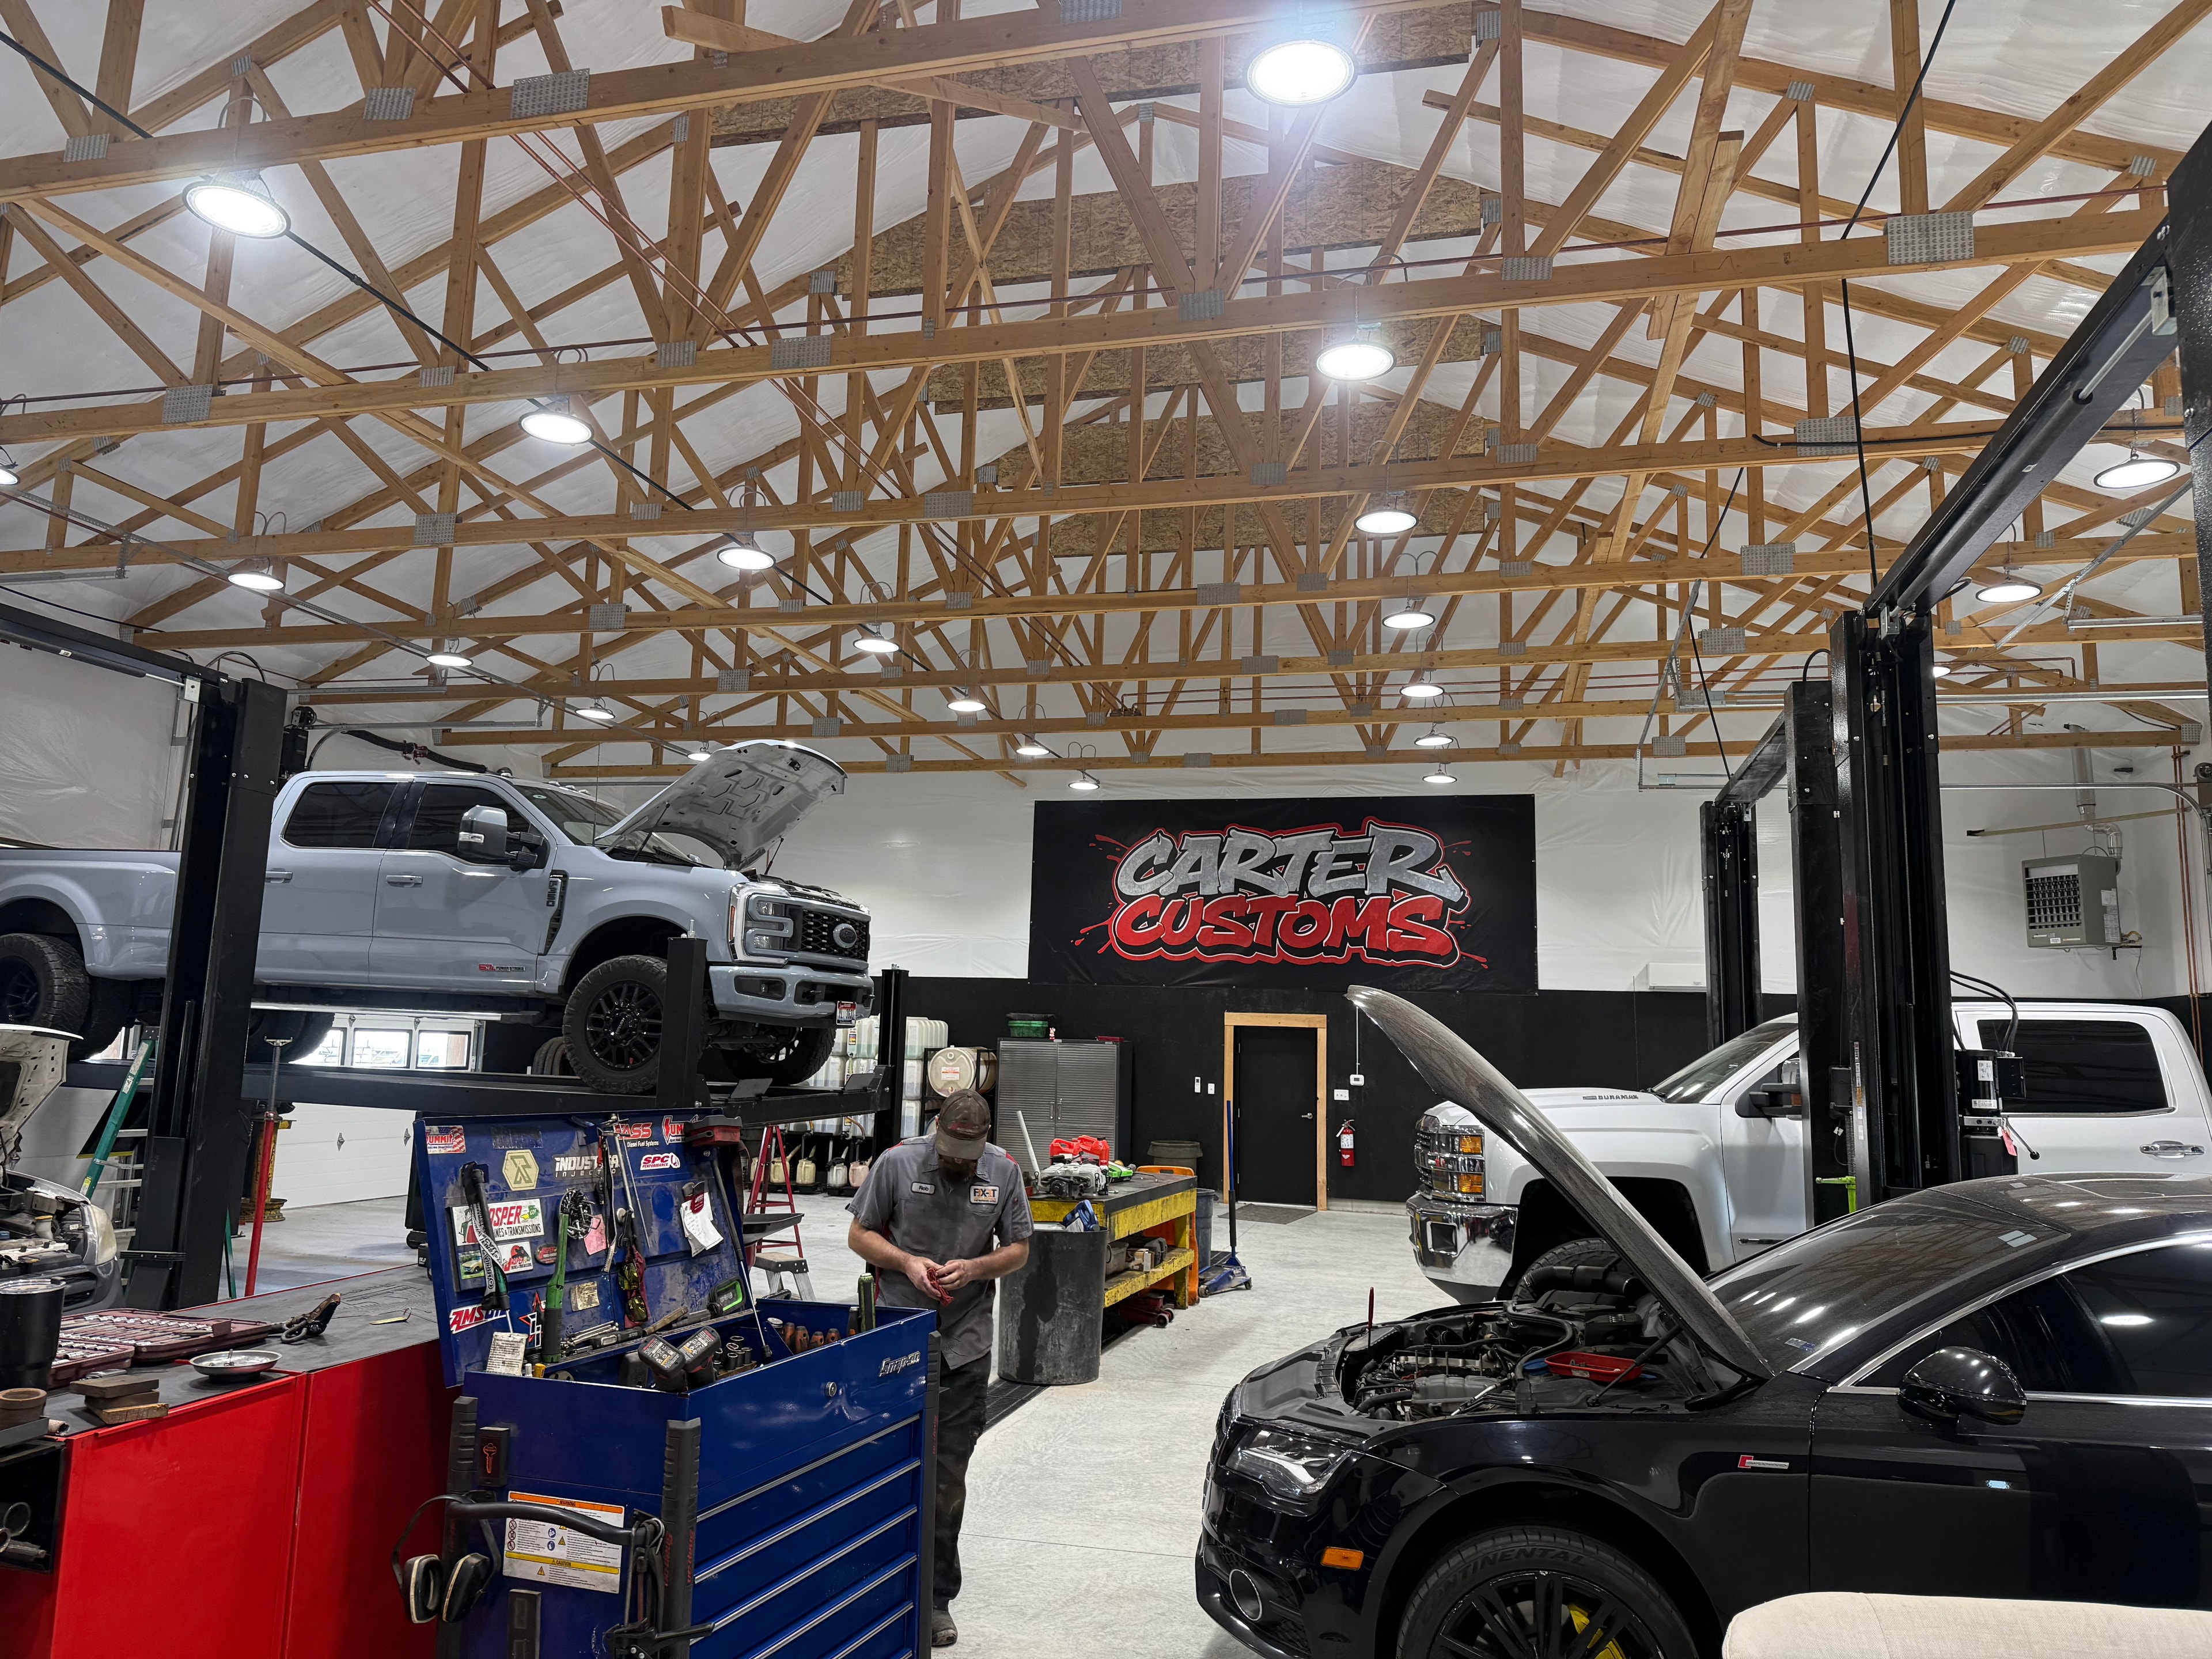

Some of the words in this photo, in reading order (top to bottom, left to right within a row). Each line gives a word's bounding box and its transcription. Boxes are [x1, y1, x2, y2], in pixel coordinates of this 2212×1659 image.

[1116, 819, 1464, 903] CARTER
[1114, 892, 1456, 957] CUSTOMS
[555, 1155, 620, 1172] INDUSTA
[643, 1155, 669, 1164] SPC
[555, 1169, 616, 1177] INJECTO
[490, 1205, 522, 1227] ASPER
[507, 1224, 541, 1236] TRANSMISSIONS
